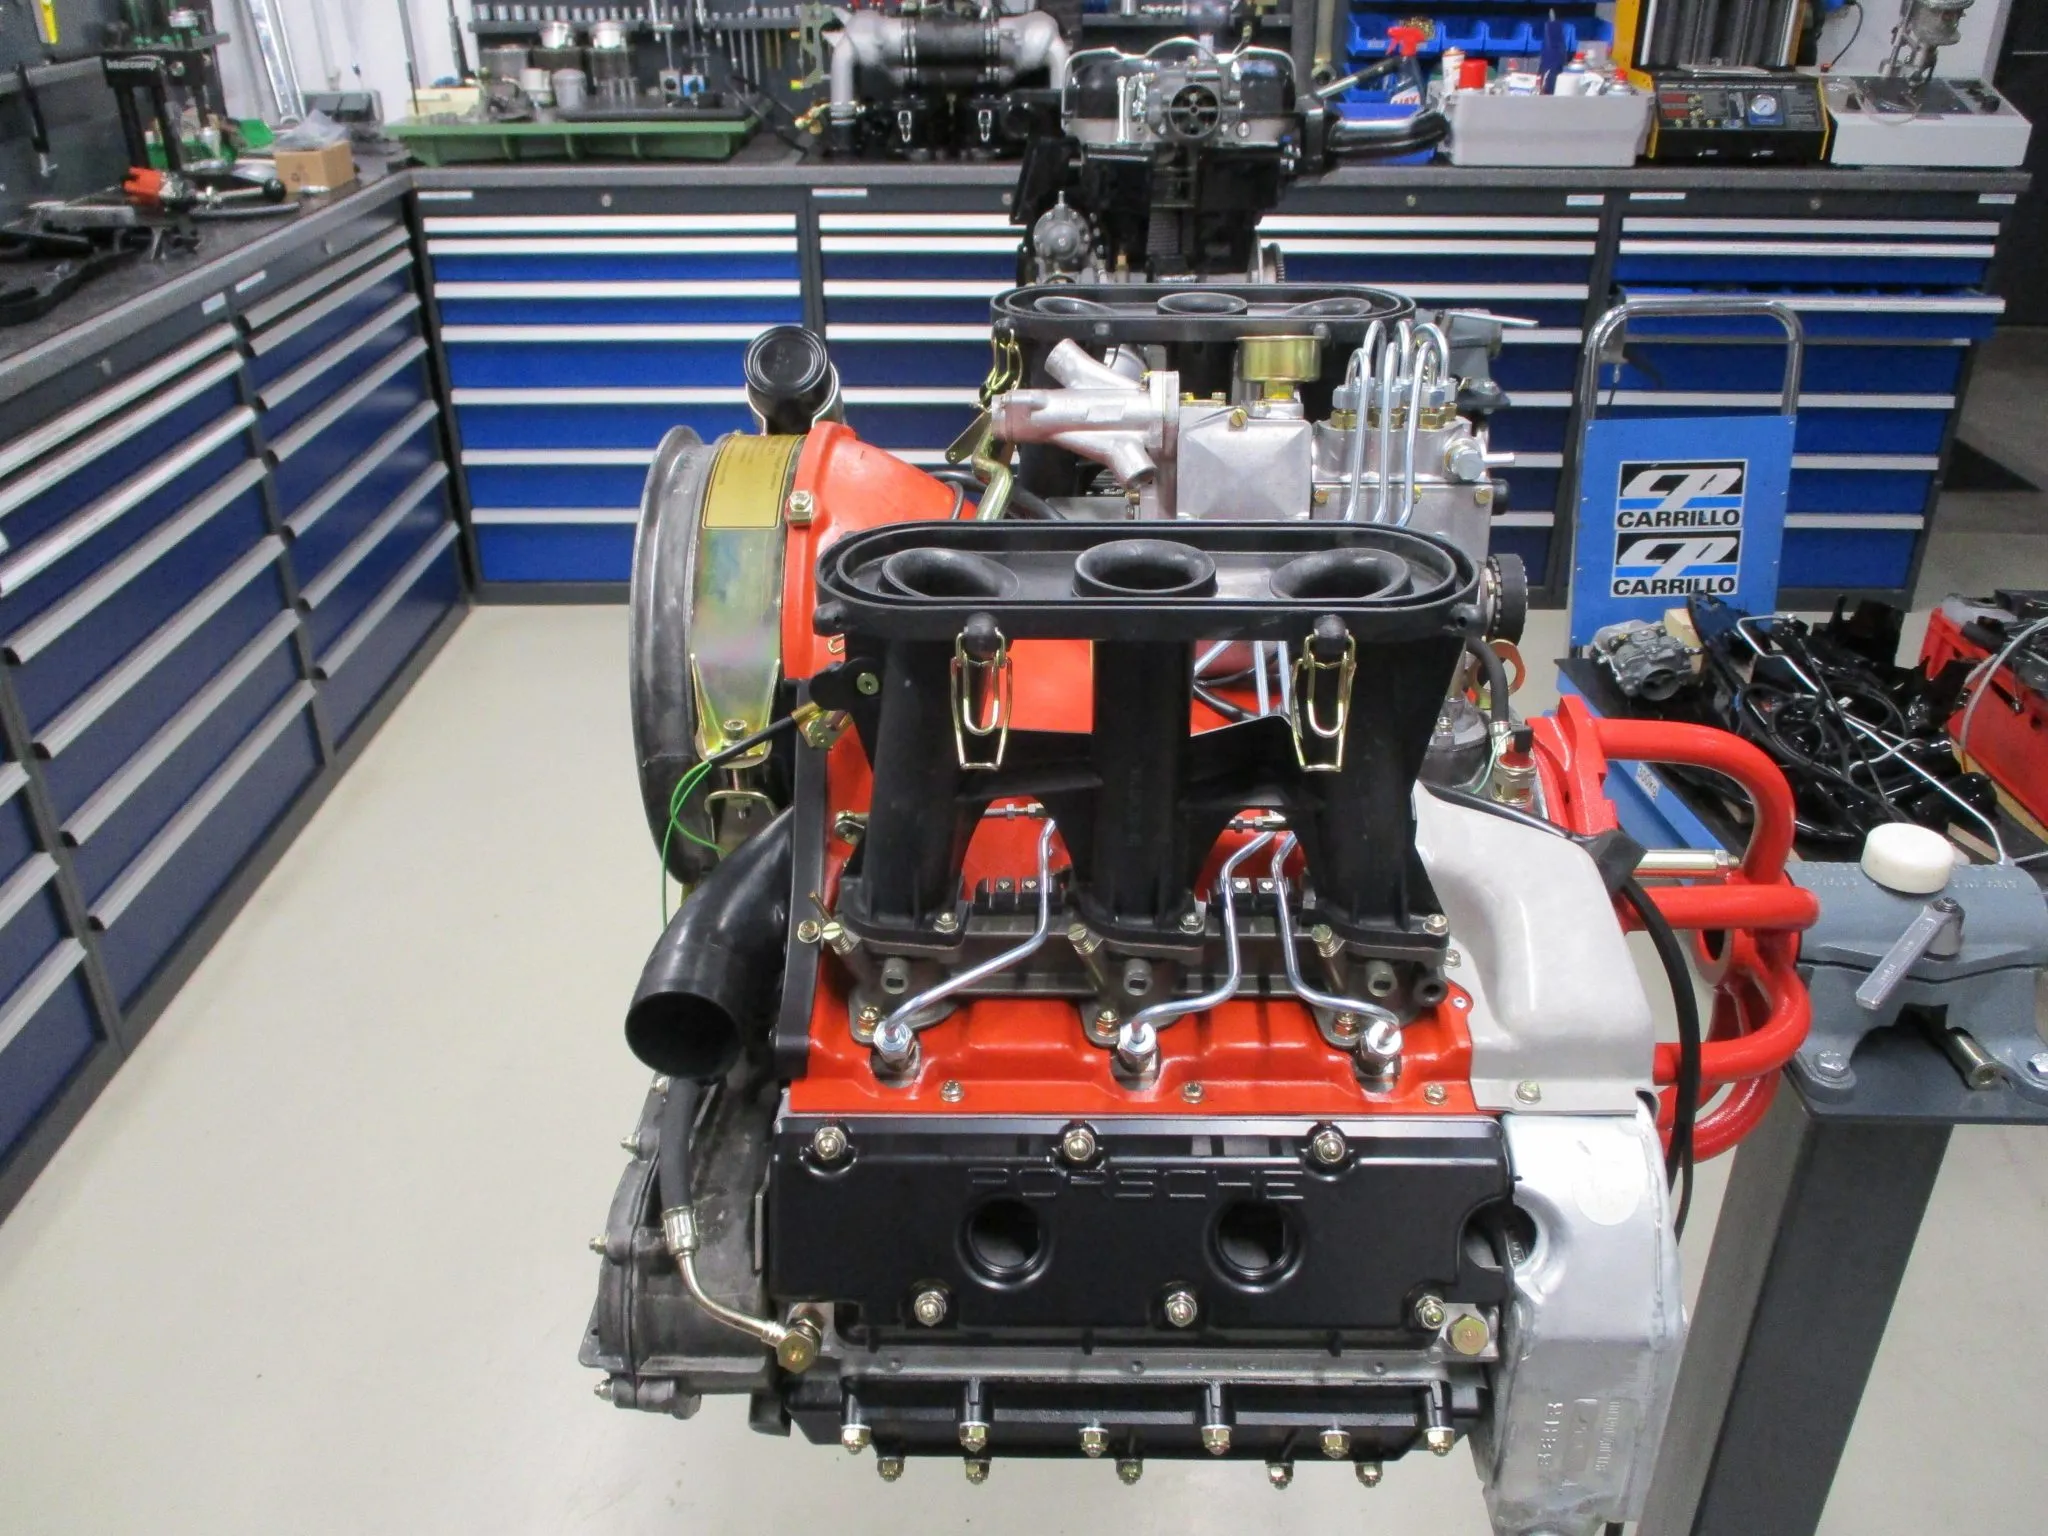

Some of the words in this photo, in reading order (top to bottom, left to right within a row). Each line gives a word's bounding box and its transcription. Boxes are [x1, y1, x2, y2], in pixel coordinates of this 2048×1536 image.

[1617, 509, 1740, 528] CARRILLO
[1613, 577, 1735, 596] CARRILLO
[968, 1167, 1304, 1201] PORSCHE
